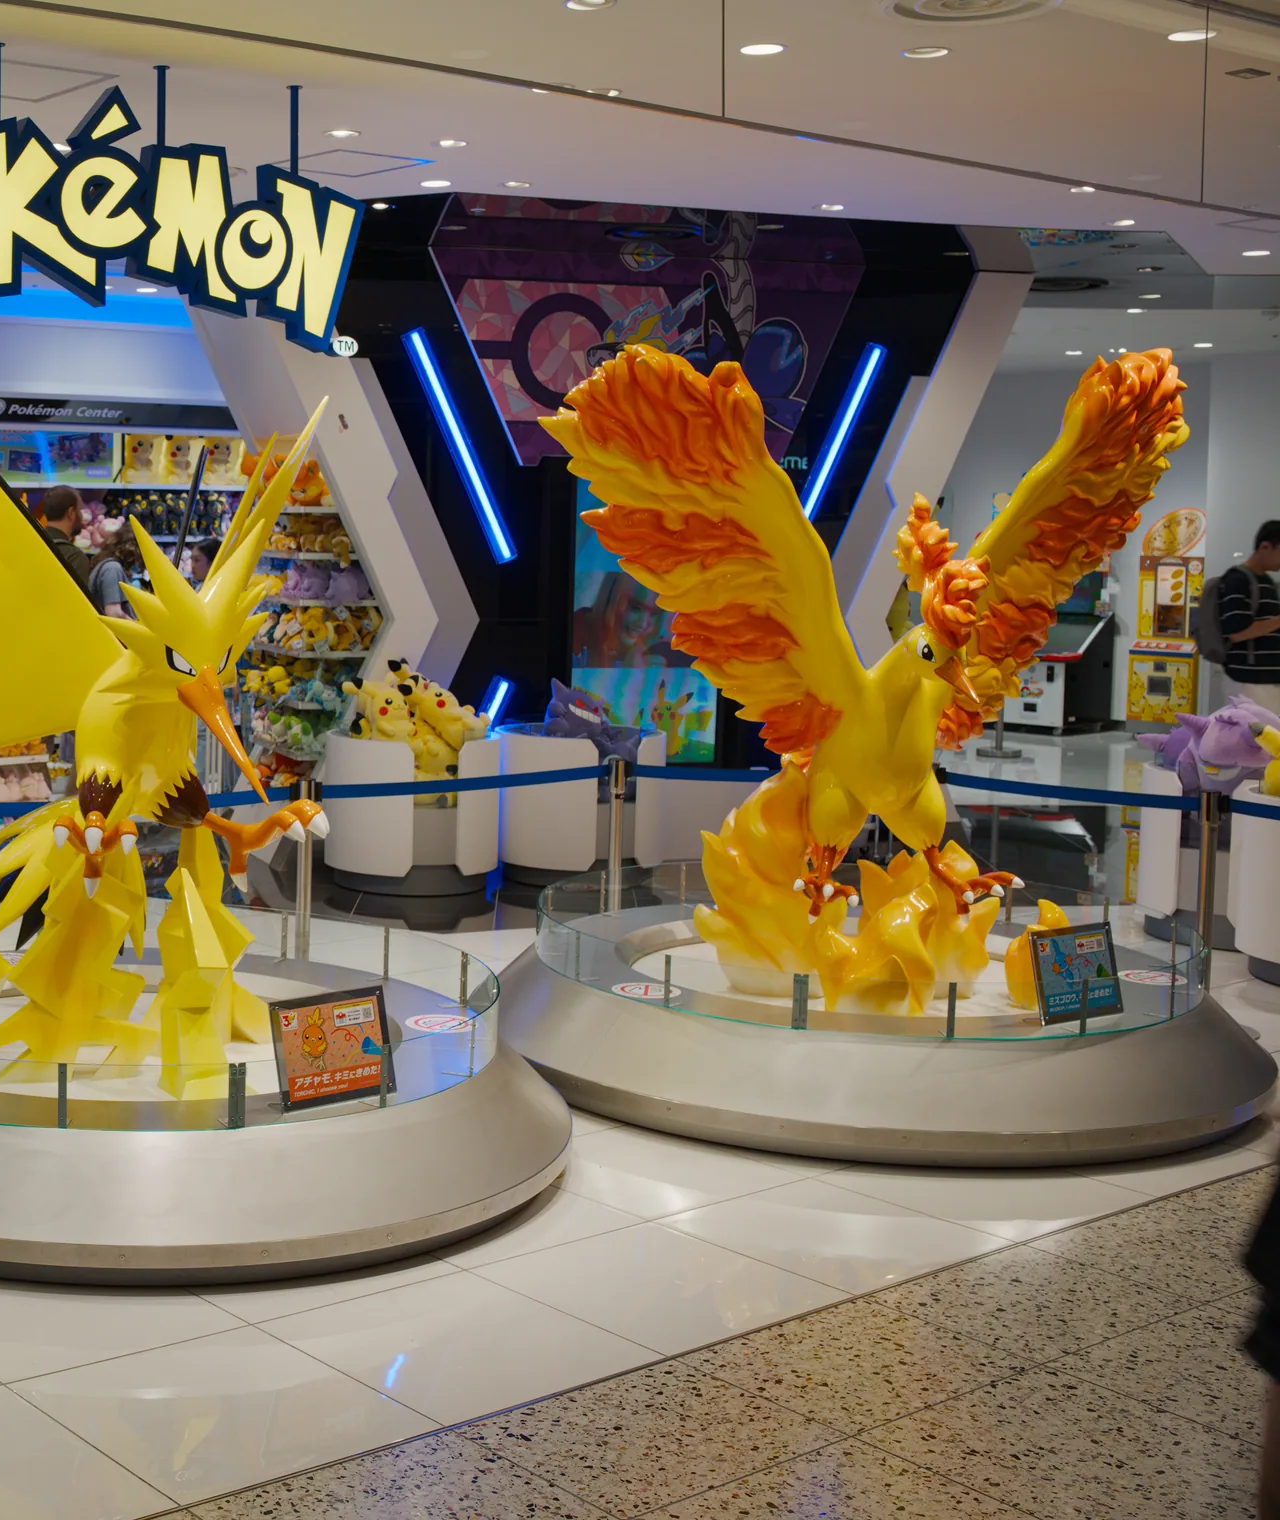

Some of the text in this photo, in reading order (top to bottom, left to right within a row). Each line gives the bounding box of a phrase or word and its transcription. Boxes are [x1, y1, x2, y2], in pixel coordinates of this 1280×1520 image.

[337, 339, 355, 352] TM
[8, 403, 123, 418] Pokémon Center
